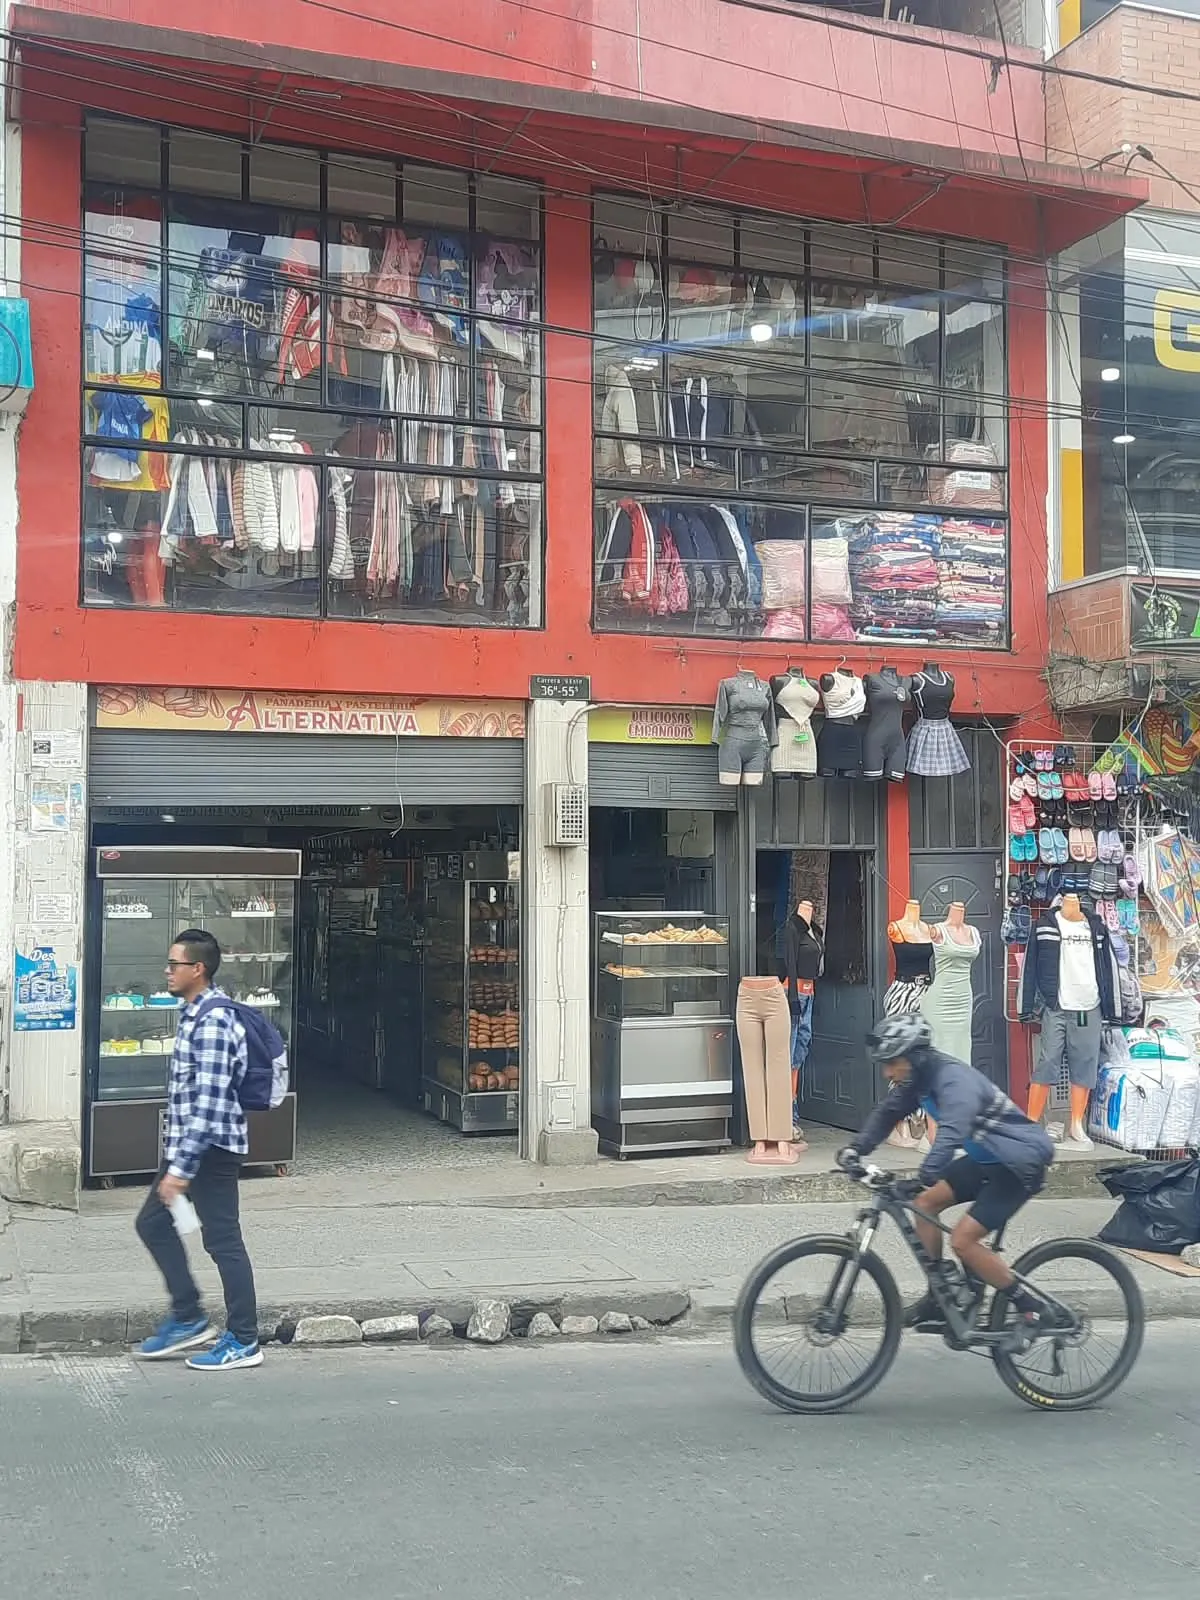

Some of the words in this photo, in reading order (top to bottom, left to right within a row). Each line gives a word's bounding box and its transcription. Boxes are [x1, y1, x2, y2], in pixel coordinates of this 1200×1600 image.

[536, 677, 561, 685] Carrera
[227, 692, 418, 732] ALTERNATIVA
[632, 711, 691, 725] DELICIOSAS
[629, 724, 694, 739] EMPANADAS
